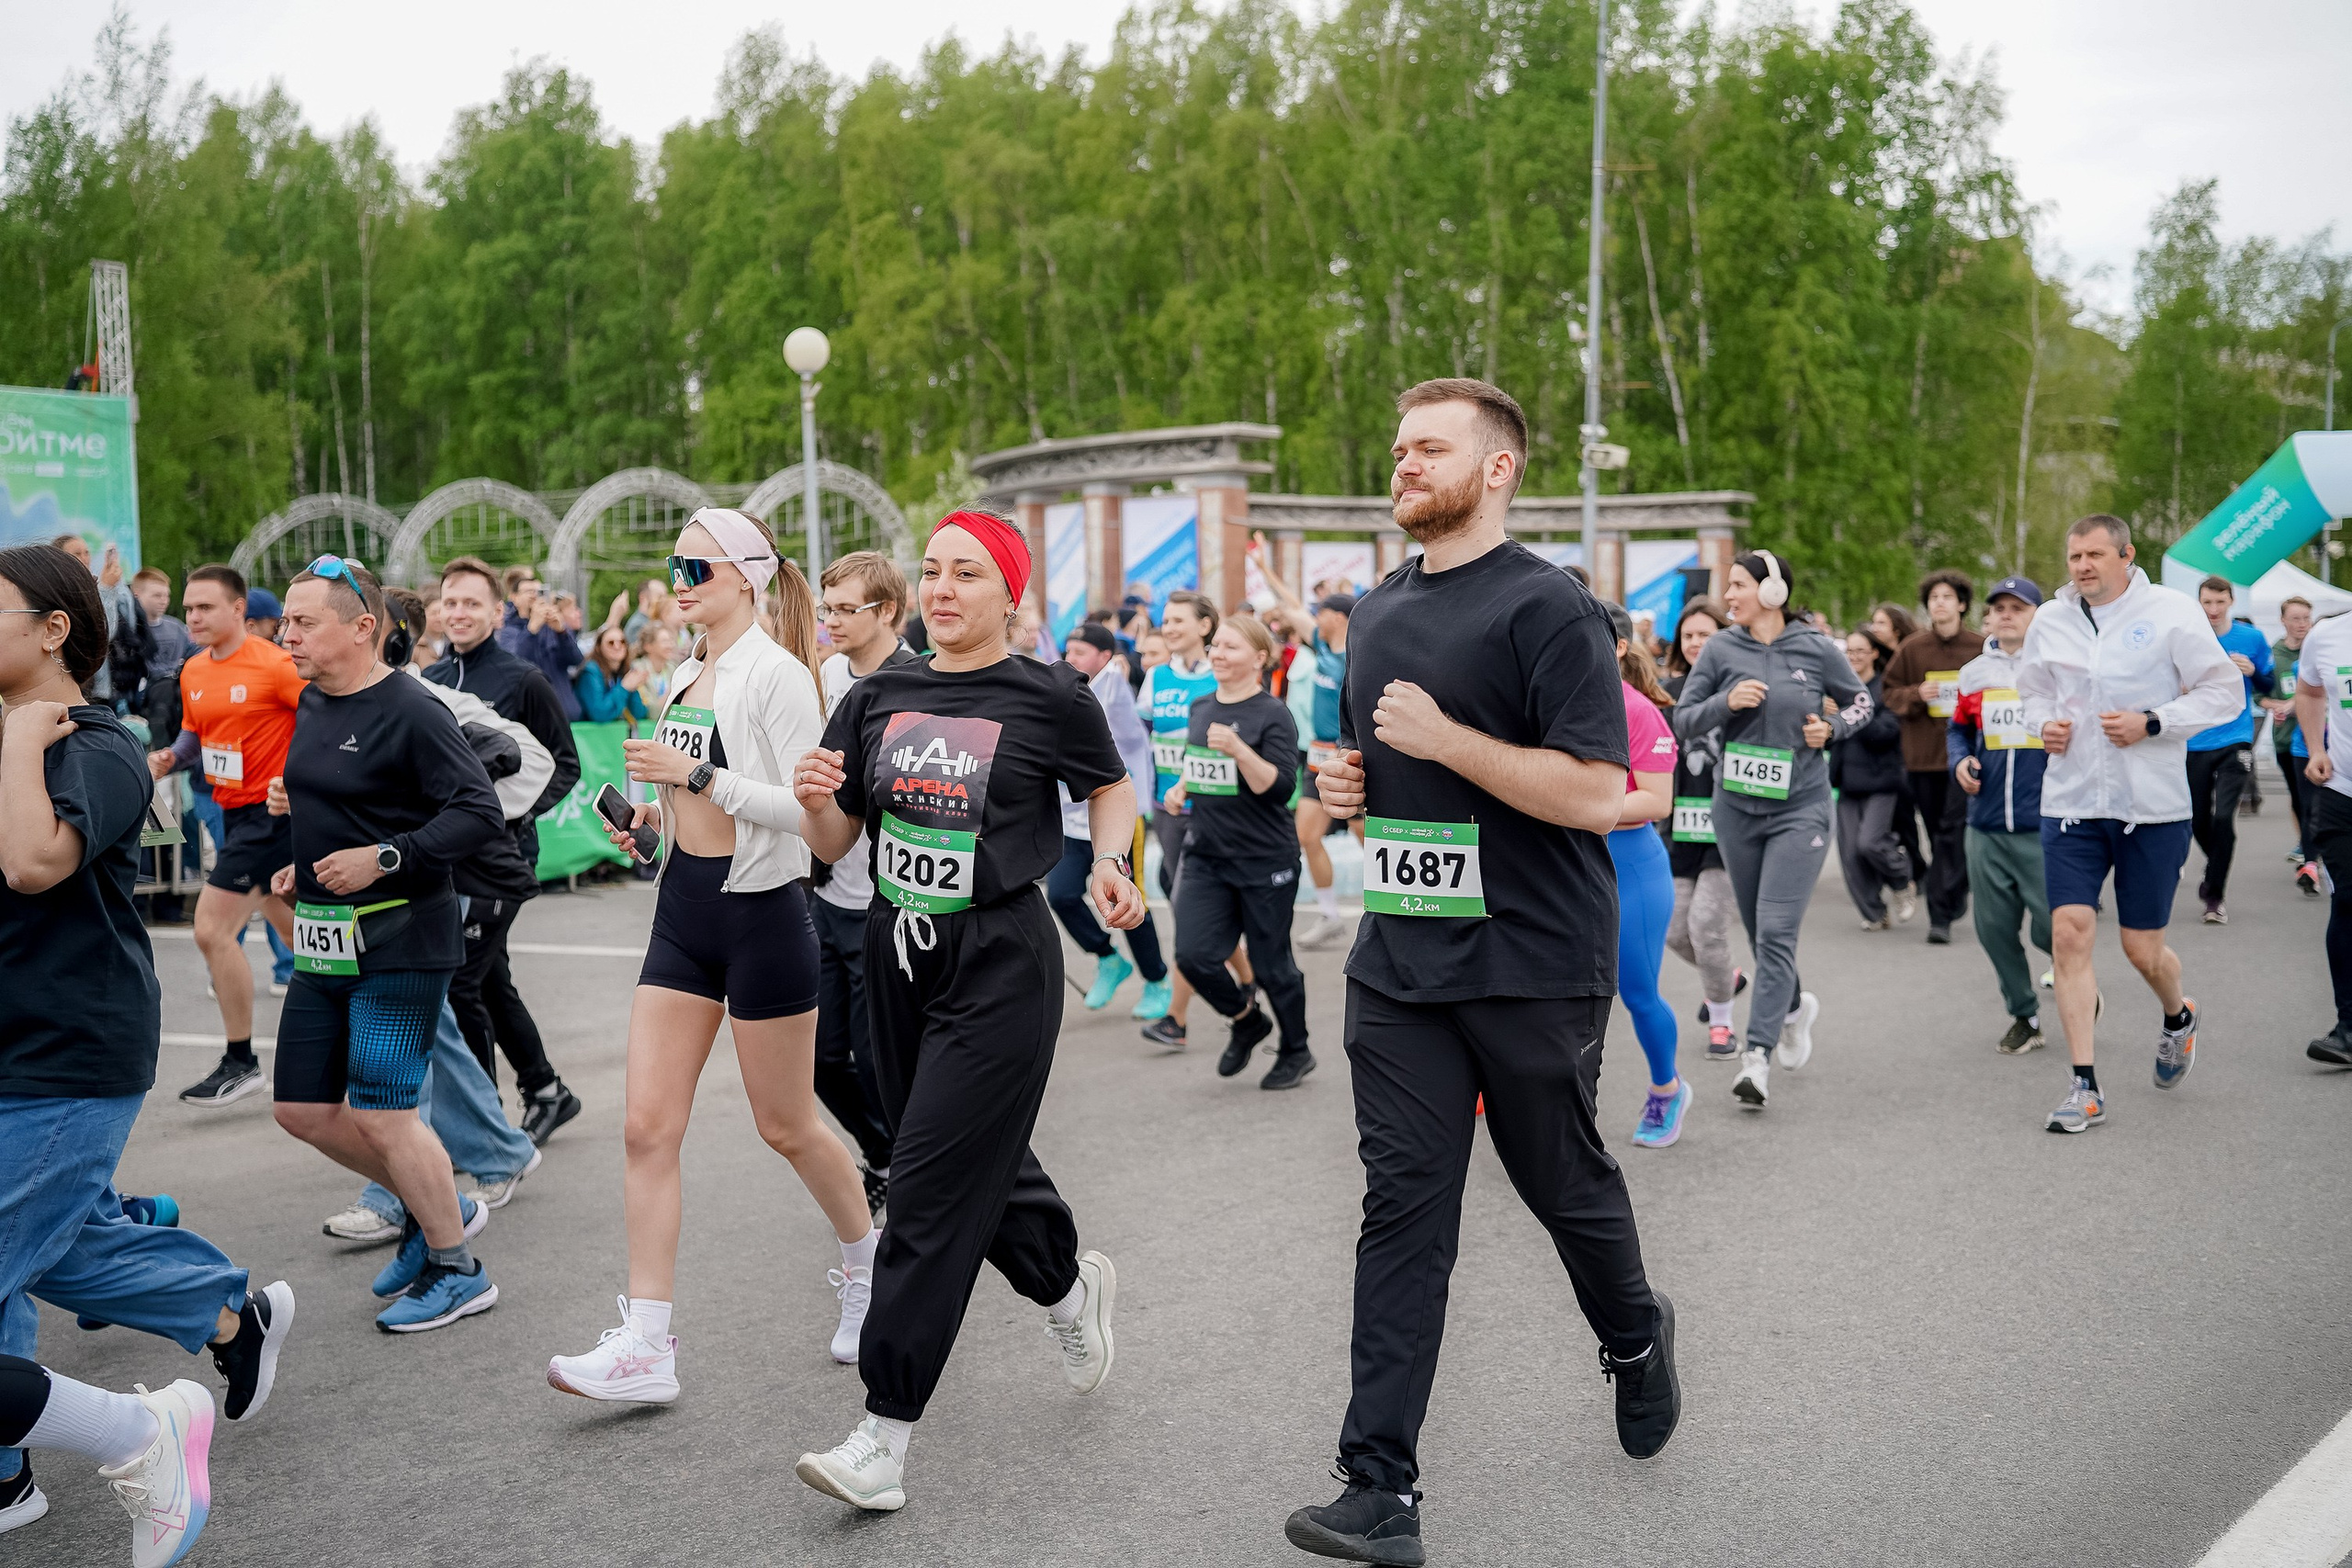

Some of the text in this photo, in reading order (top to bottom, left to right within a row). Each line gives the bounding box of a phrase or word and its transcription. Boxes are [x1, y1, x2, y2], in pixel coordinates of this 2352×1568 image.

[212, 754, 227, 773] 77
[1190, 761, 1227, 780] 1321
[1732, 760, 1782, 782] 1485
[891, 777, 968, 800] АРЕНА
[893, 794, 968, 810] ЖЕНСКИЙ
[885, 840, 960, 891] 1202
[1375, 847, 1466, 889] 1687
[297, 923, 345, 953] 1451
